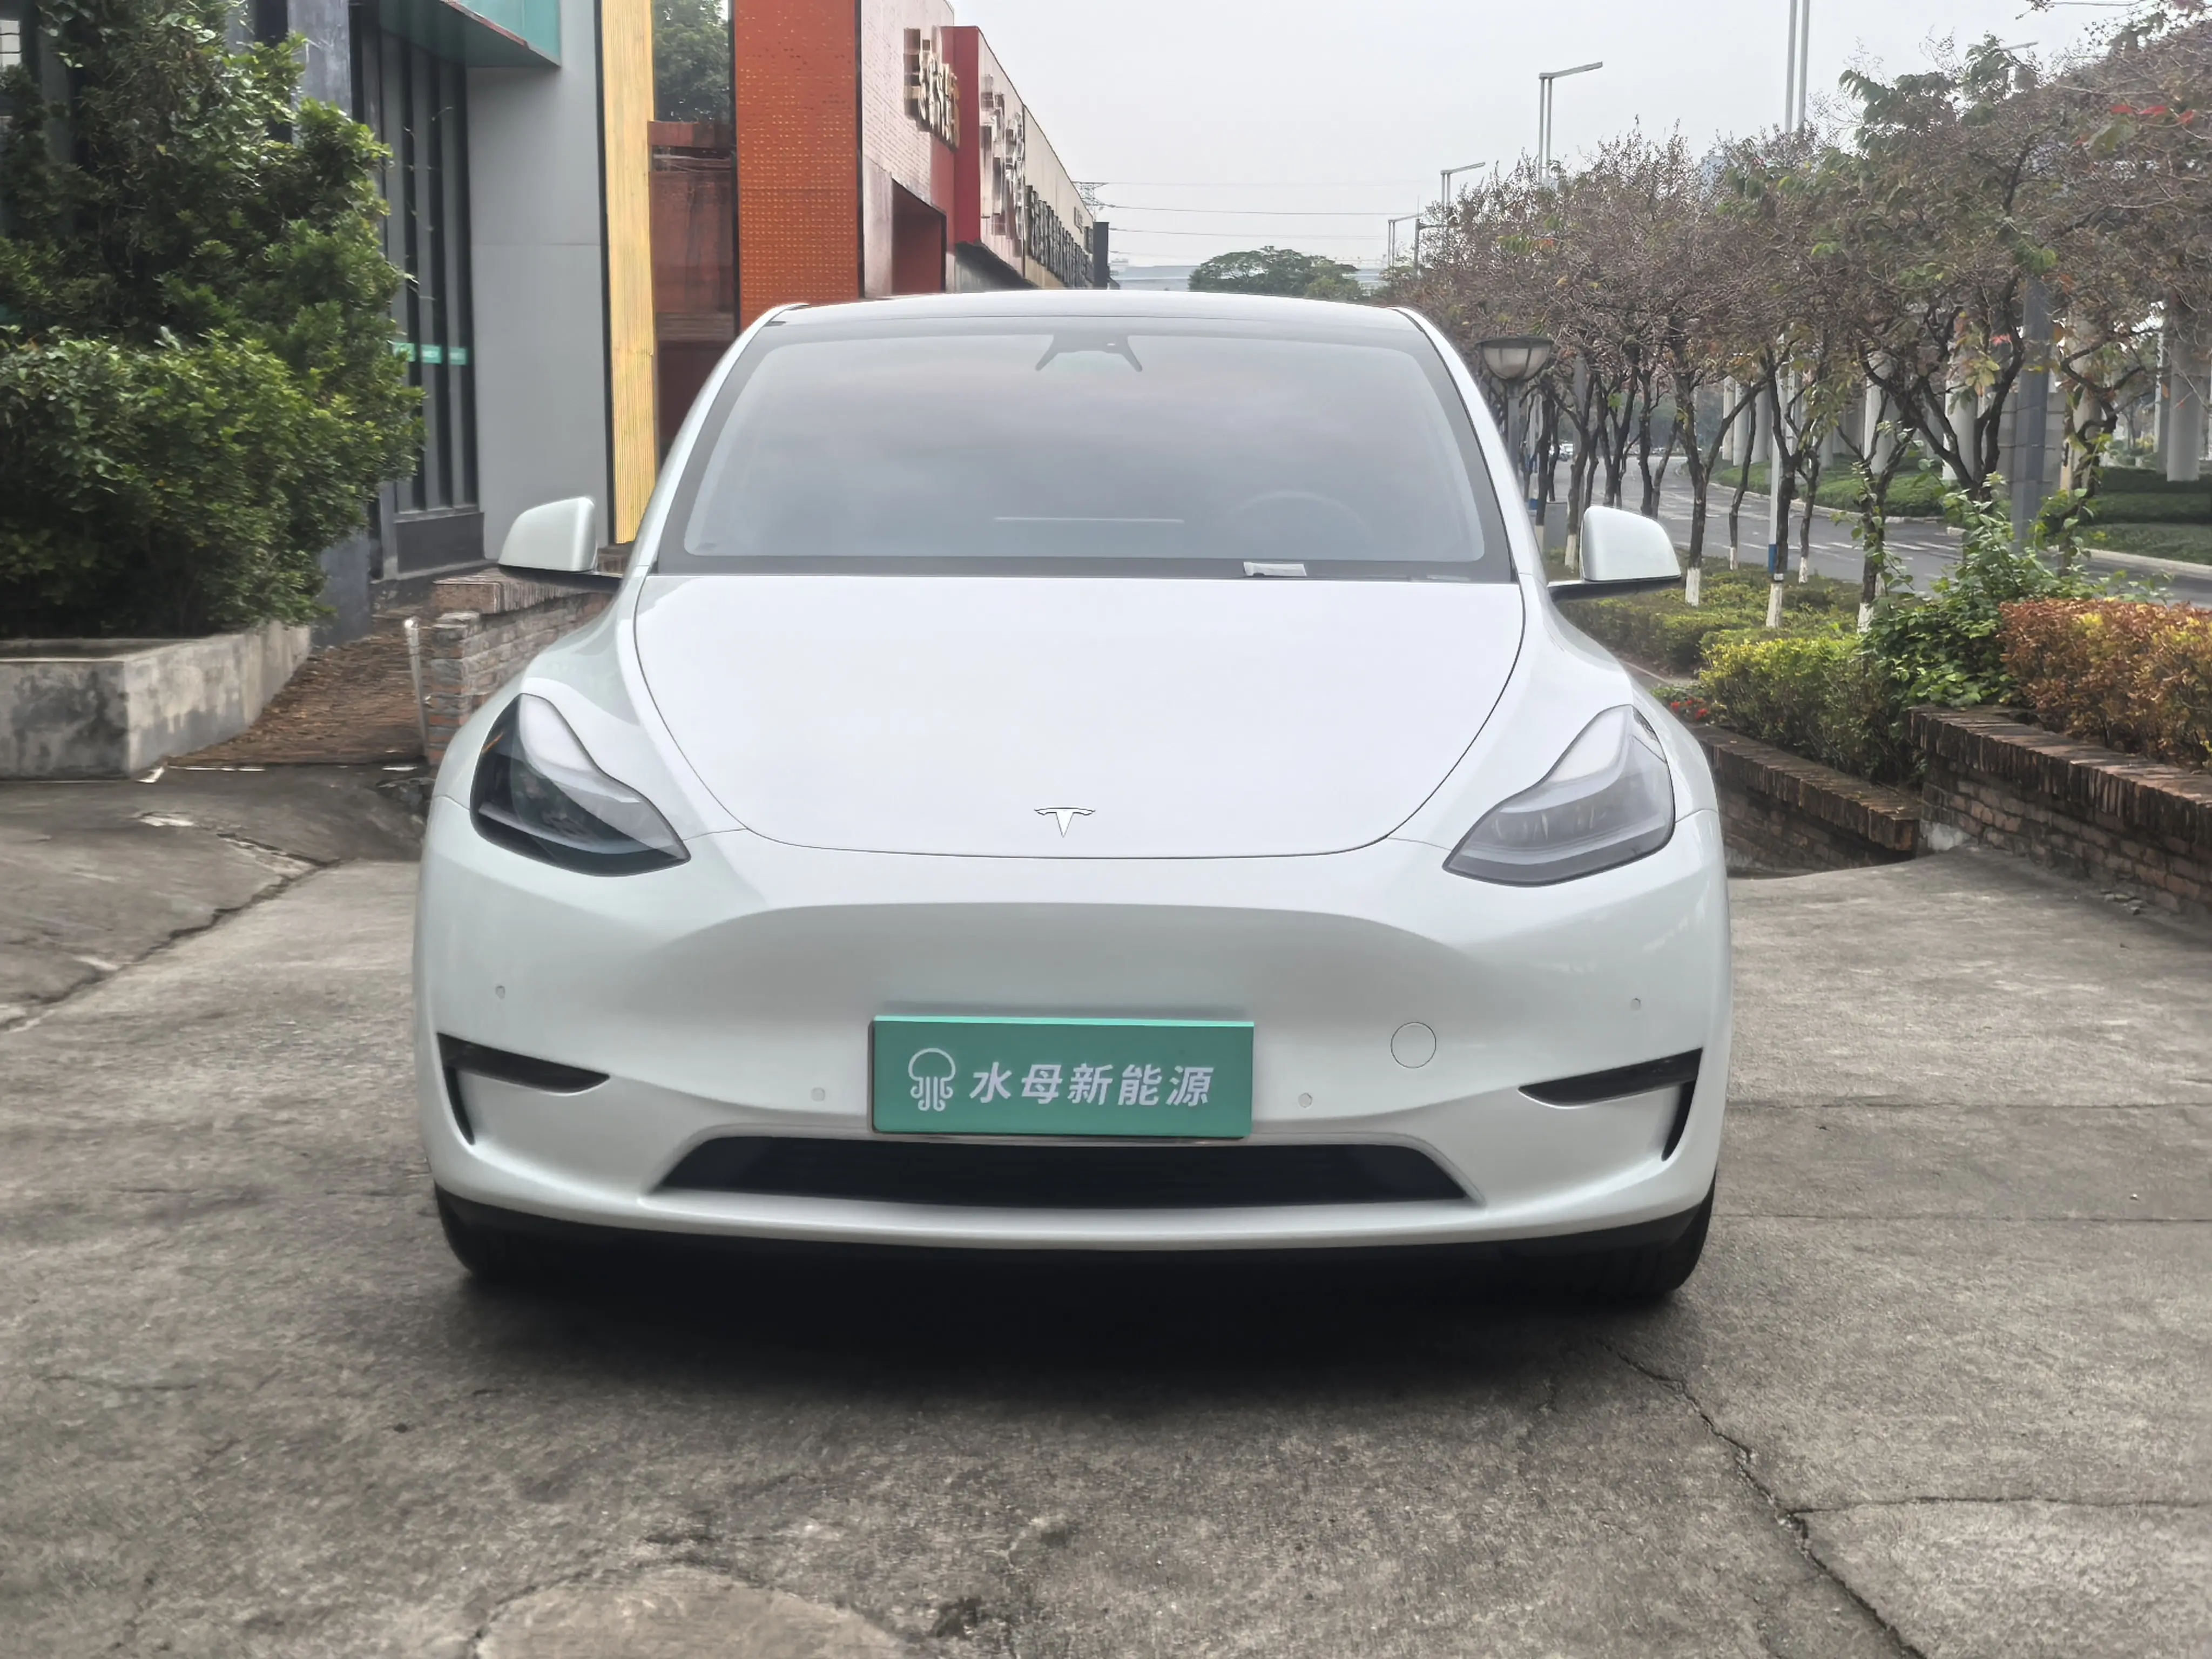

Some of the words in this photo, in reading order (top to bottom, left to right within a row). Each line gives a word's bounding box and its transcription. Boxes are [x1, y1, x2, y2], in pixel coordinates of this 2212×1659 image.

[969, 1061, 1214, 1107] 水母新能源
